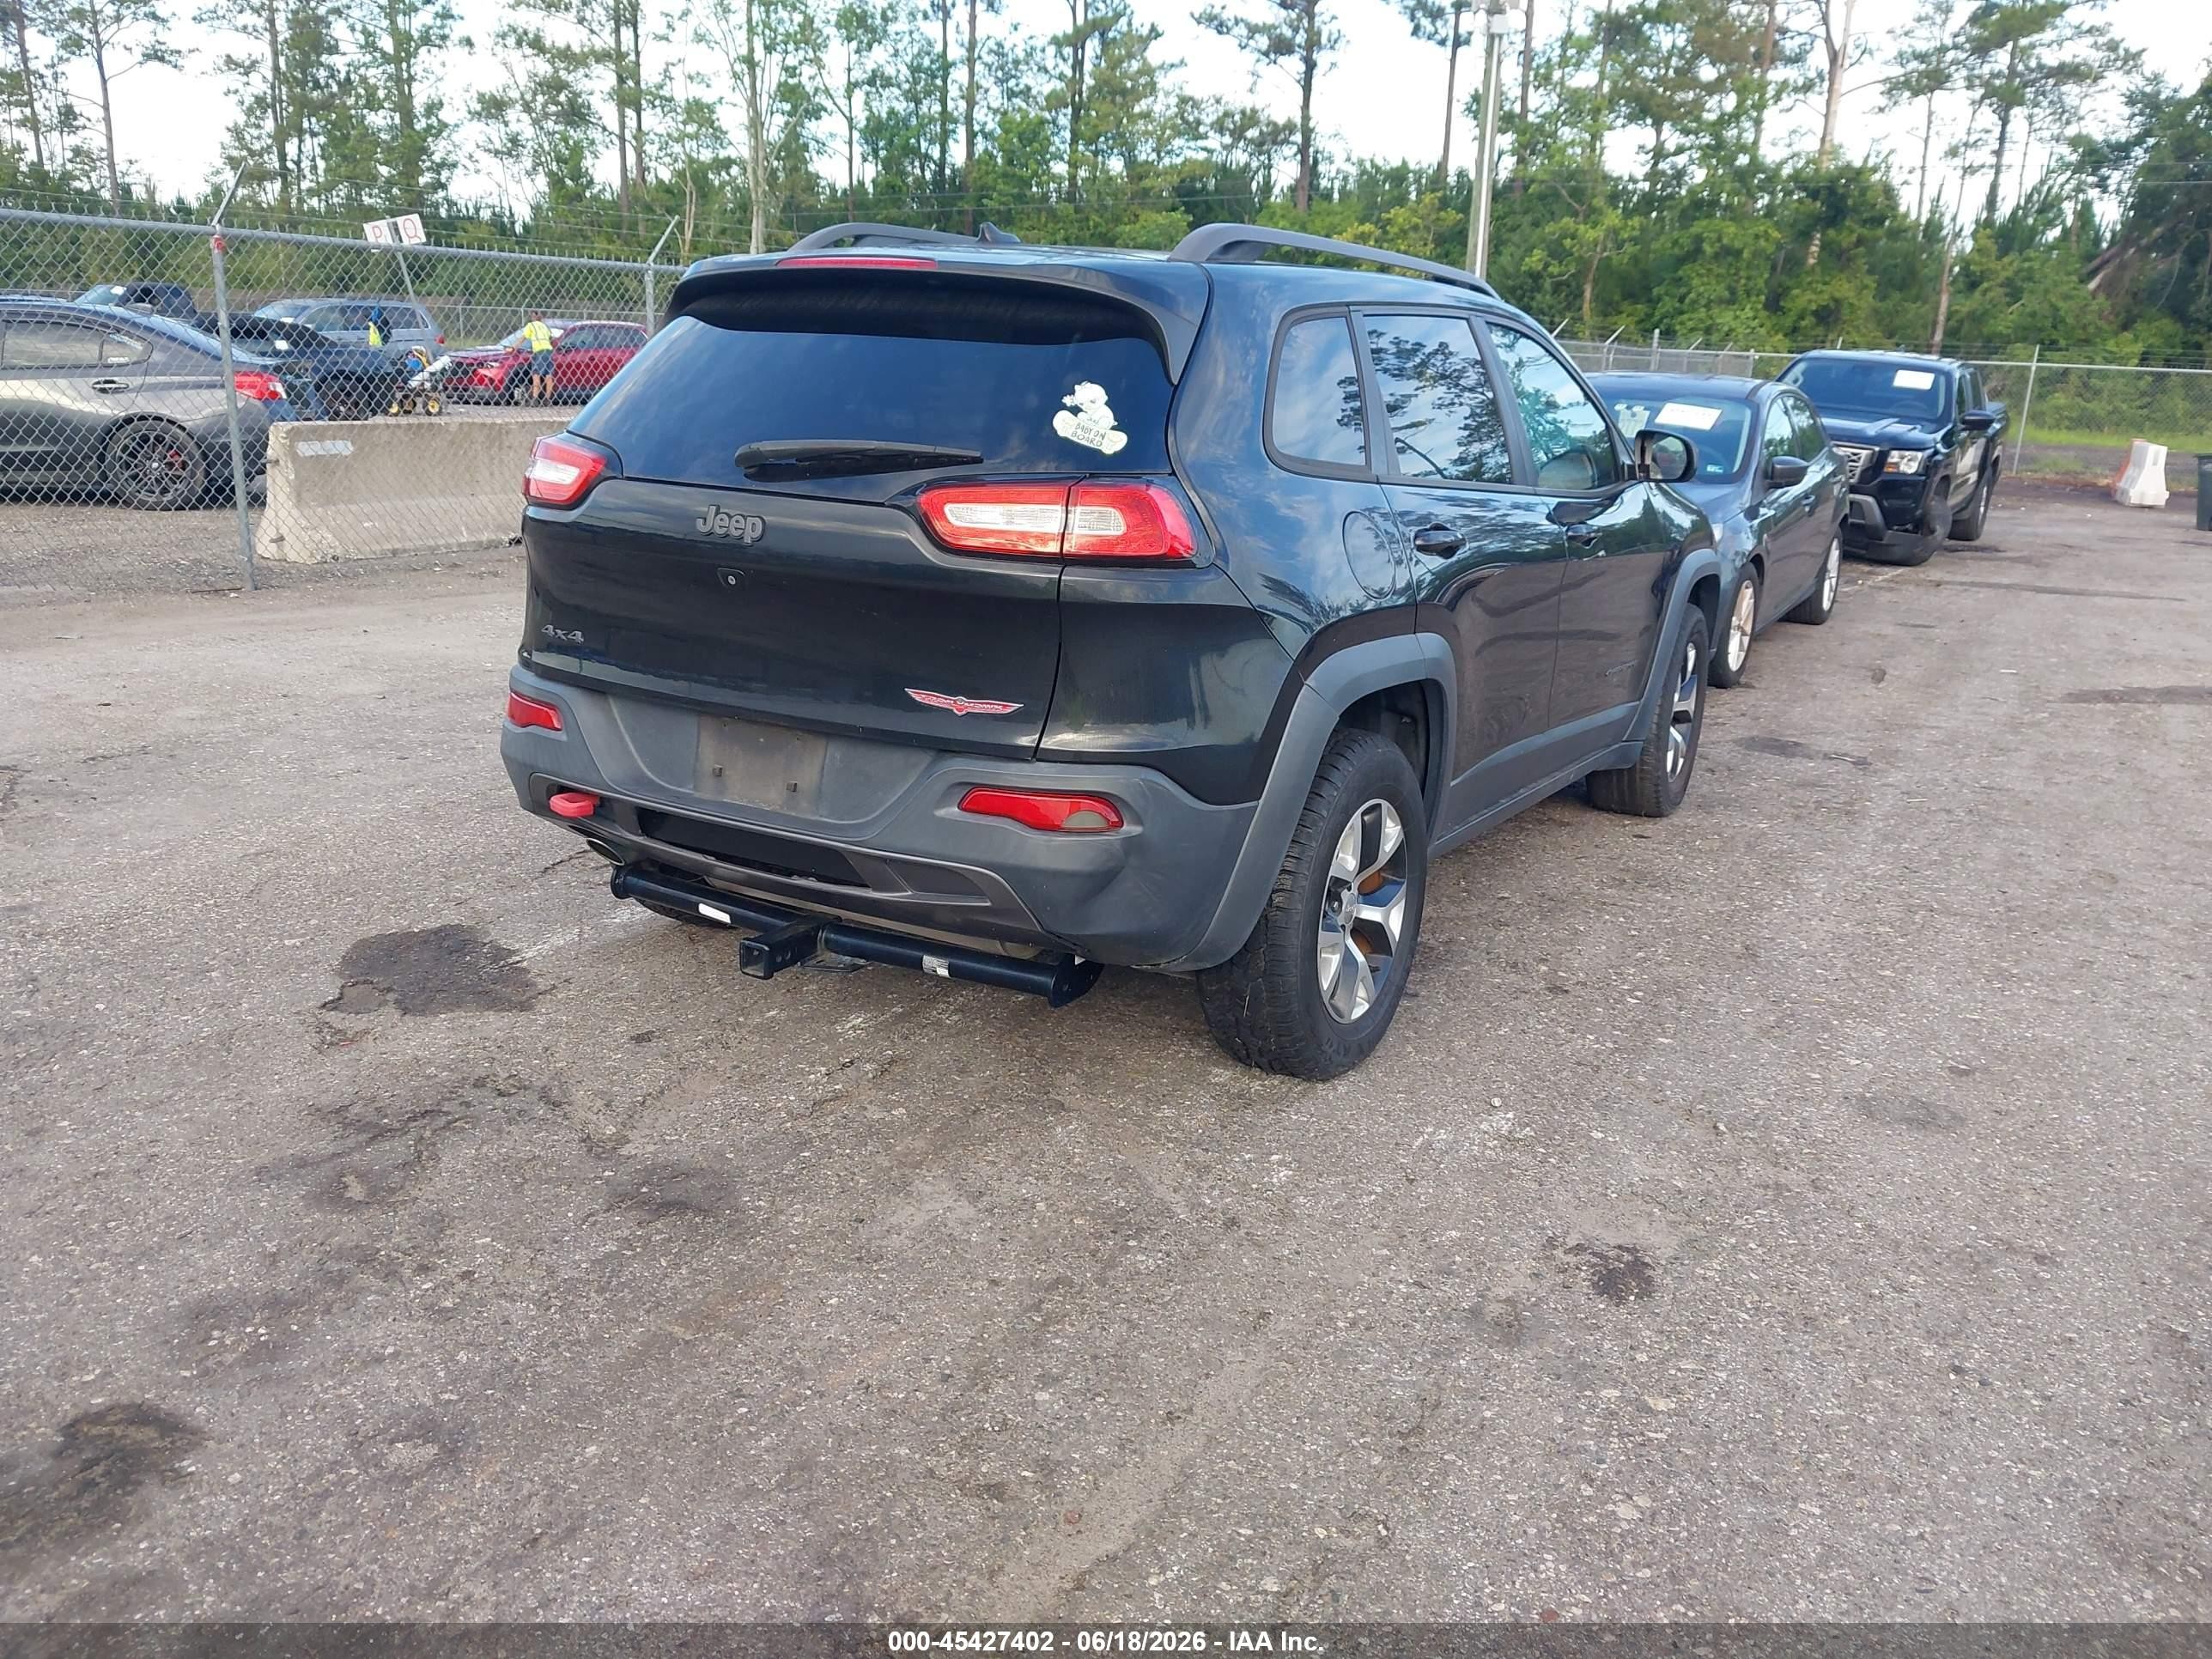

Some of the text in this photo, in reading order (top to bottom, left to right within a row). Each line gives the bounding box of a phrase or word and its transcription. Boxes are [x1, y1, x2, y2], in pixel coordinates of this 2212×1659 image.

[1071, 430, 1103, 447] BOARD
[1093, 429, 1107, 441] ON
[696, 504, 764, 544] Jeep
[541, 624, 584, 644] 4x4
